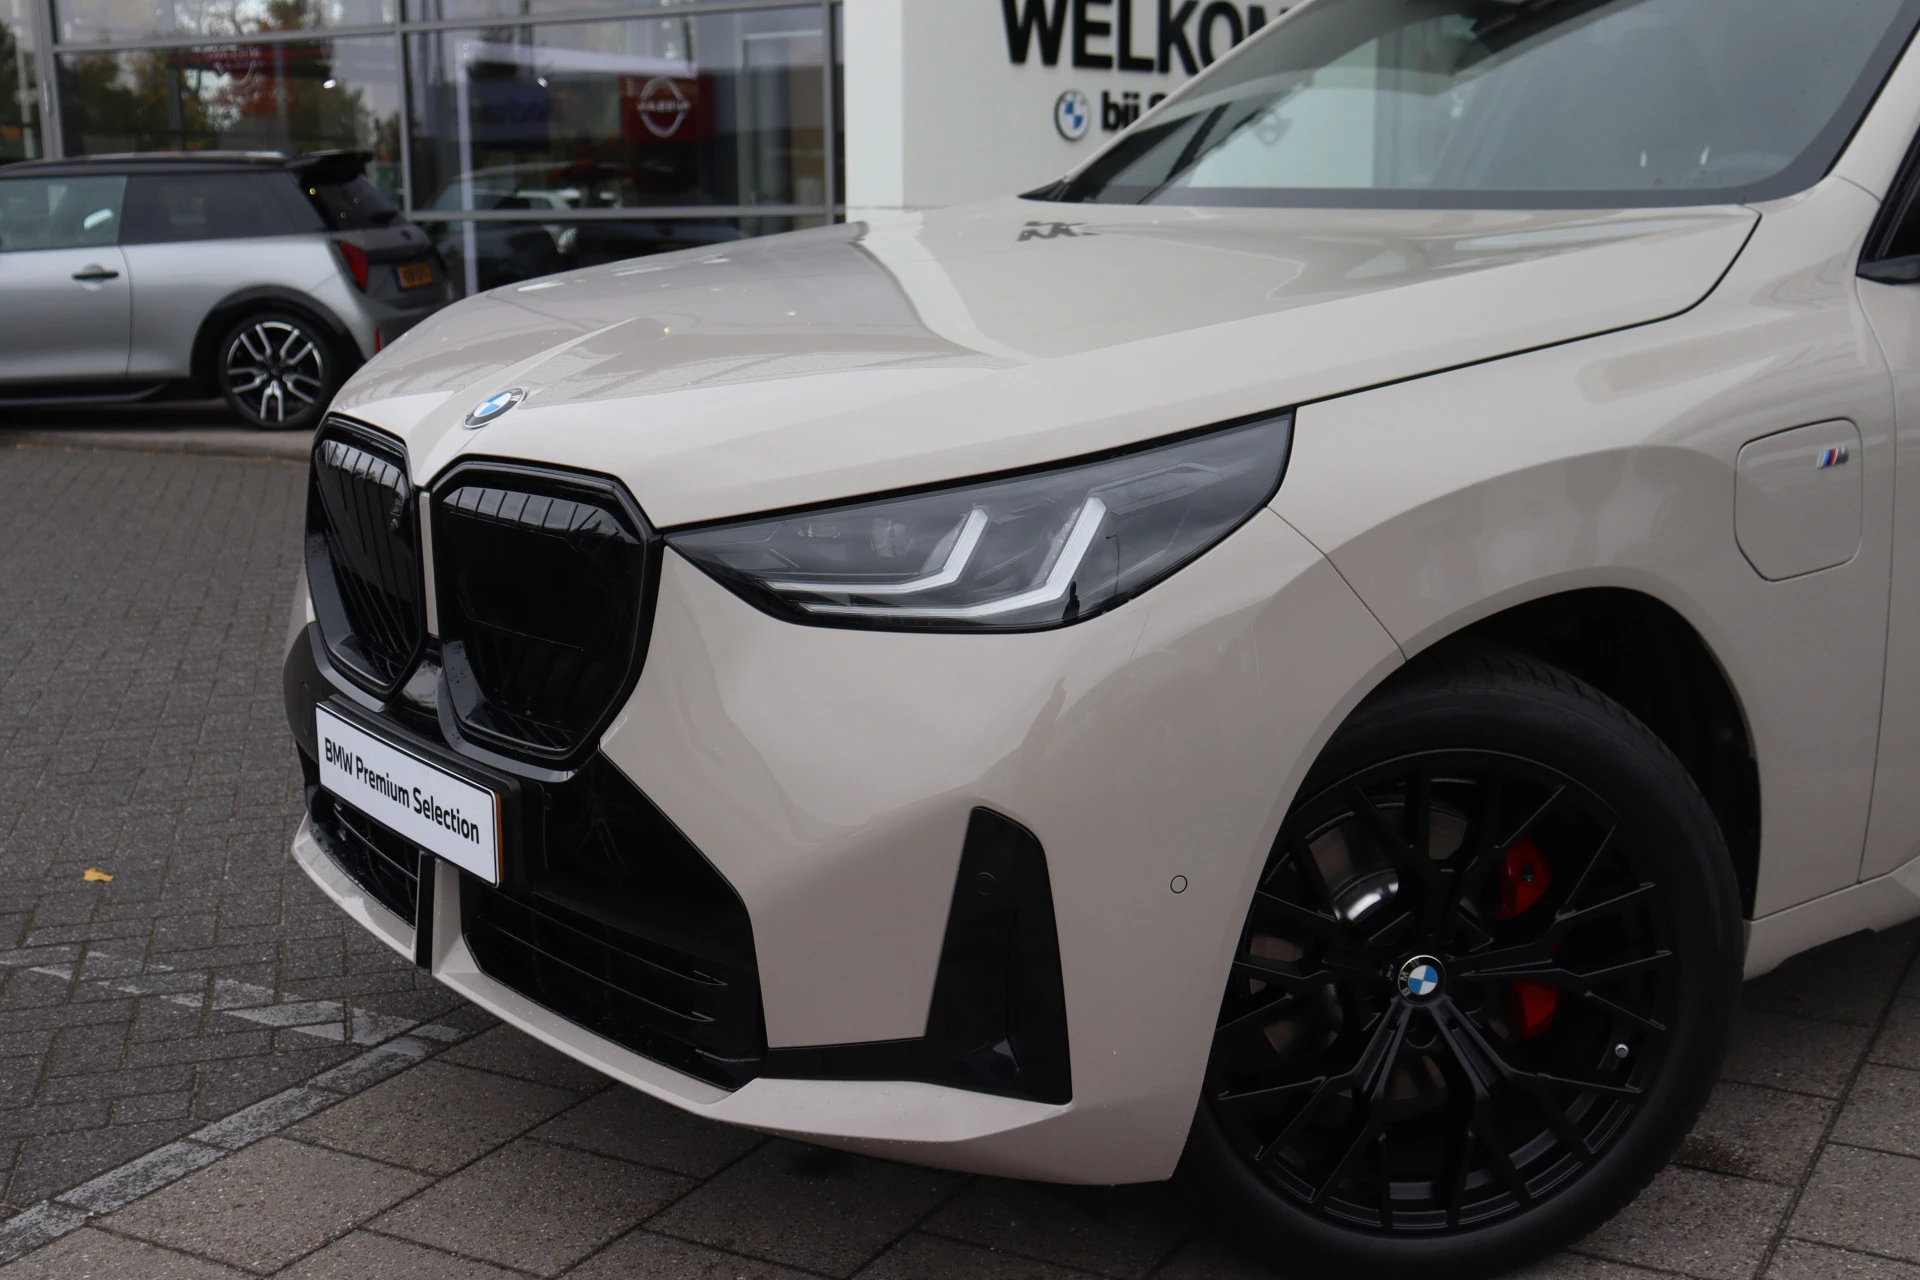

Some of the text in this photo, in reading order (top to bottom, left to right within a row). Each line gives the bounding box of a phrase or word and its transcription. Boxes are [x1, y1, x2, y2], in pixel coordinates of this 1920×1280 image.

[1001, 0, 1288, 76] WELKO
[325, 736, 480, 845] BMW Premium Selection
